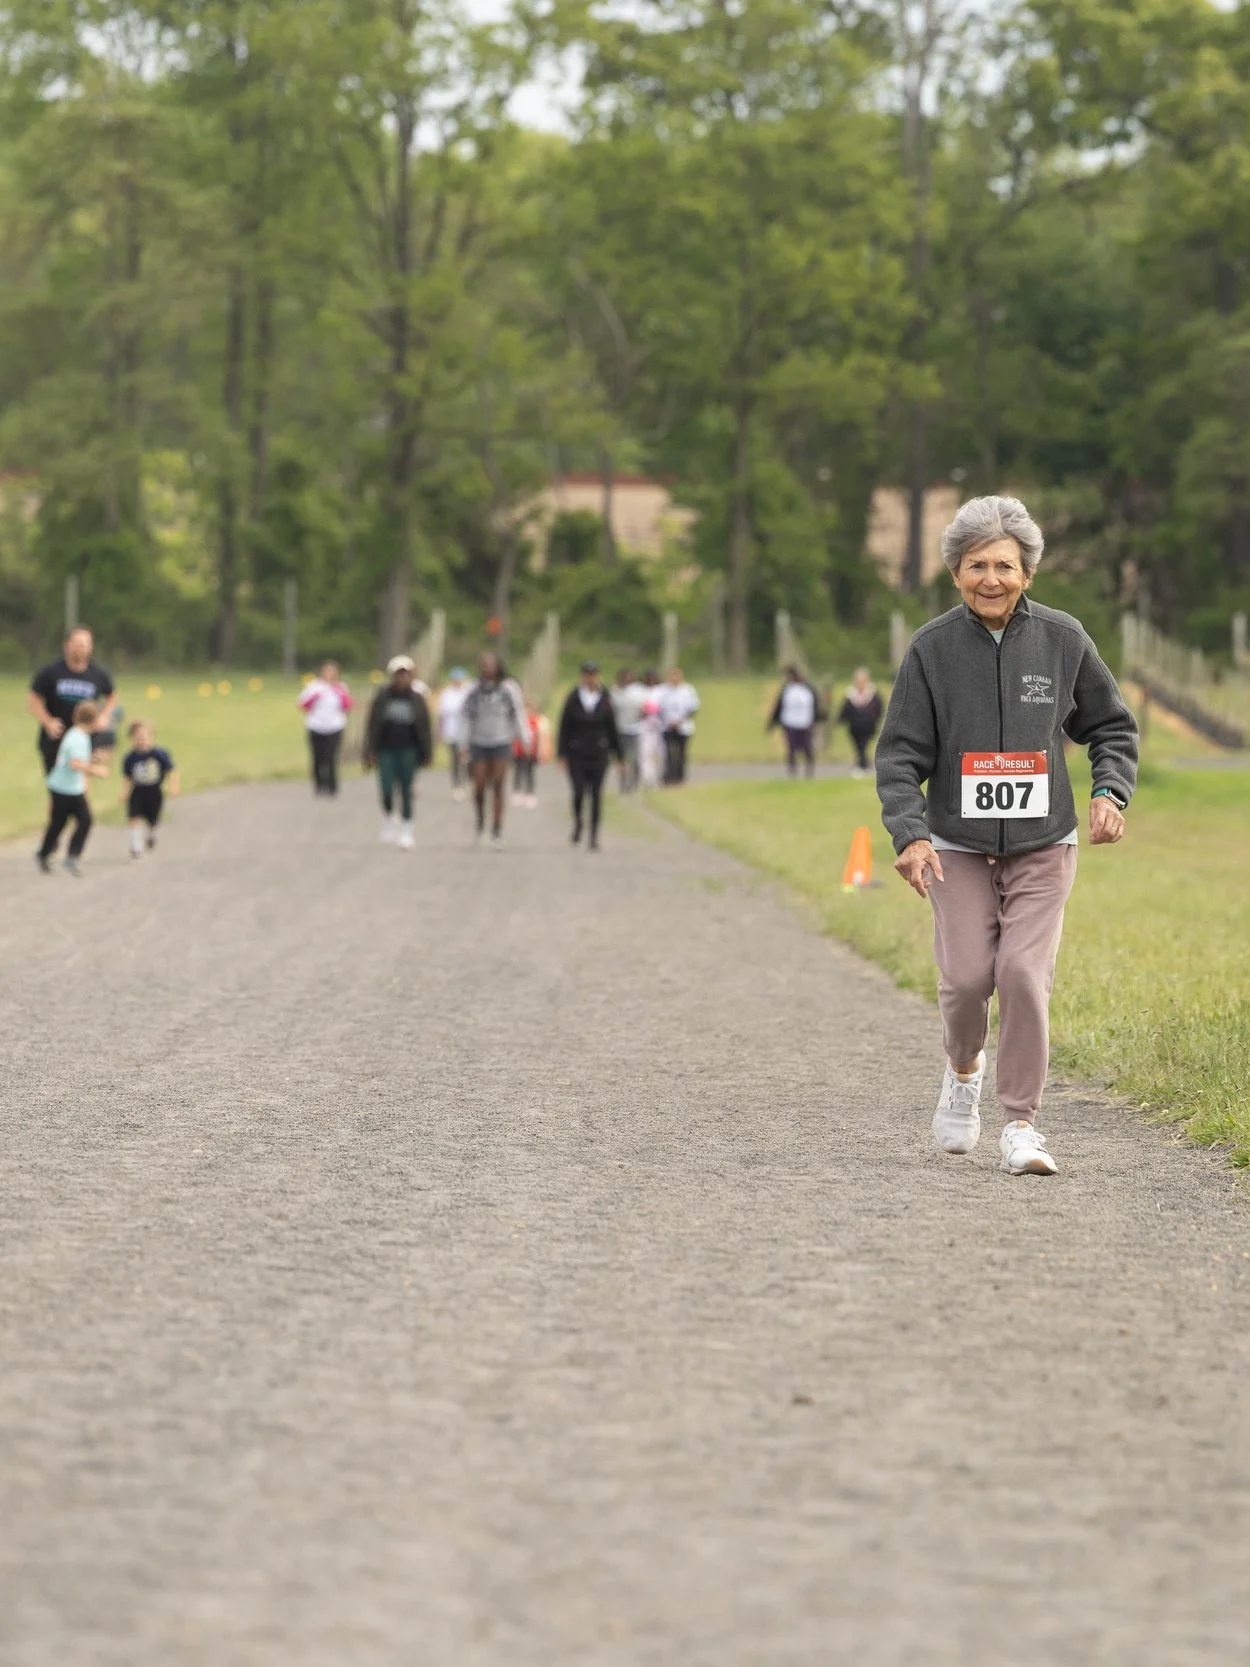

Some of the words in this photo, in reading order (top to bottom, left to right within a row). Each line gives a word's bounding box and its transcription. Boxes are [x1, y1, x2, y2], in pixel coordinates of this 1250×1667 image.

[1022, 675, 1032, 684] NEW
[974, 761, 994, 769] RACE
[1006, 760, 1035, 768] RESULT
[976, 782, 1034, 810] 807
